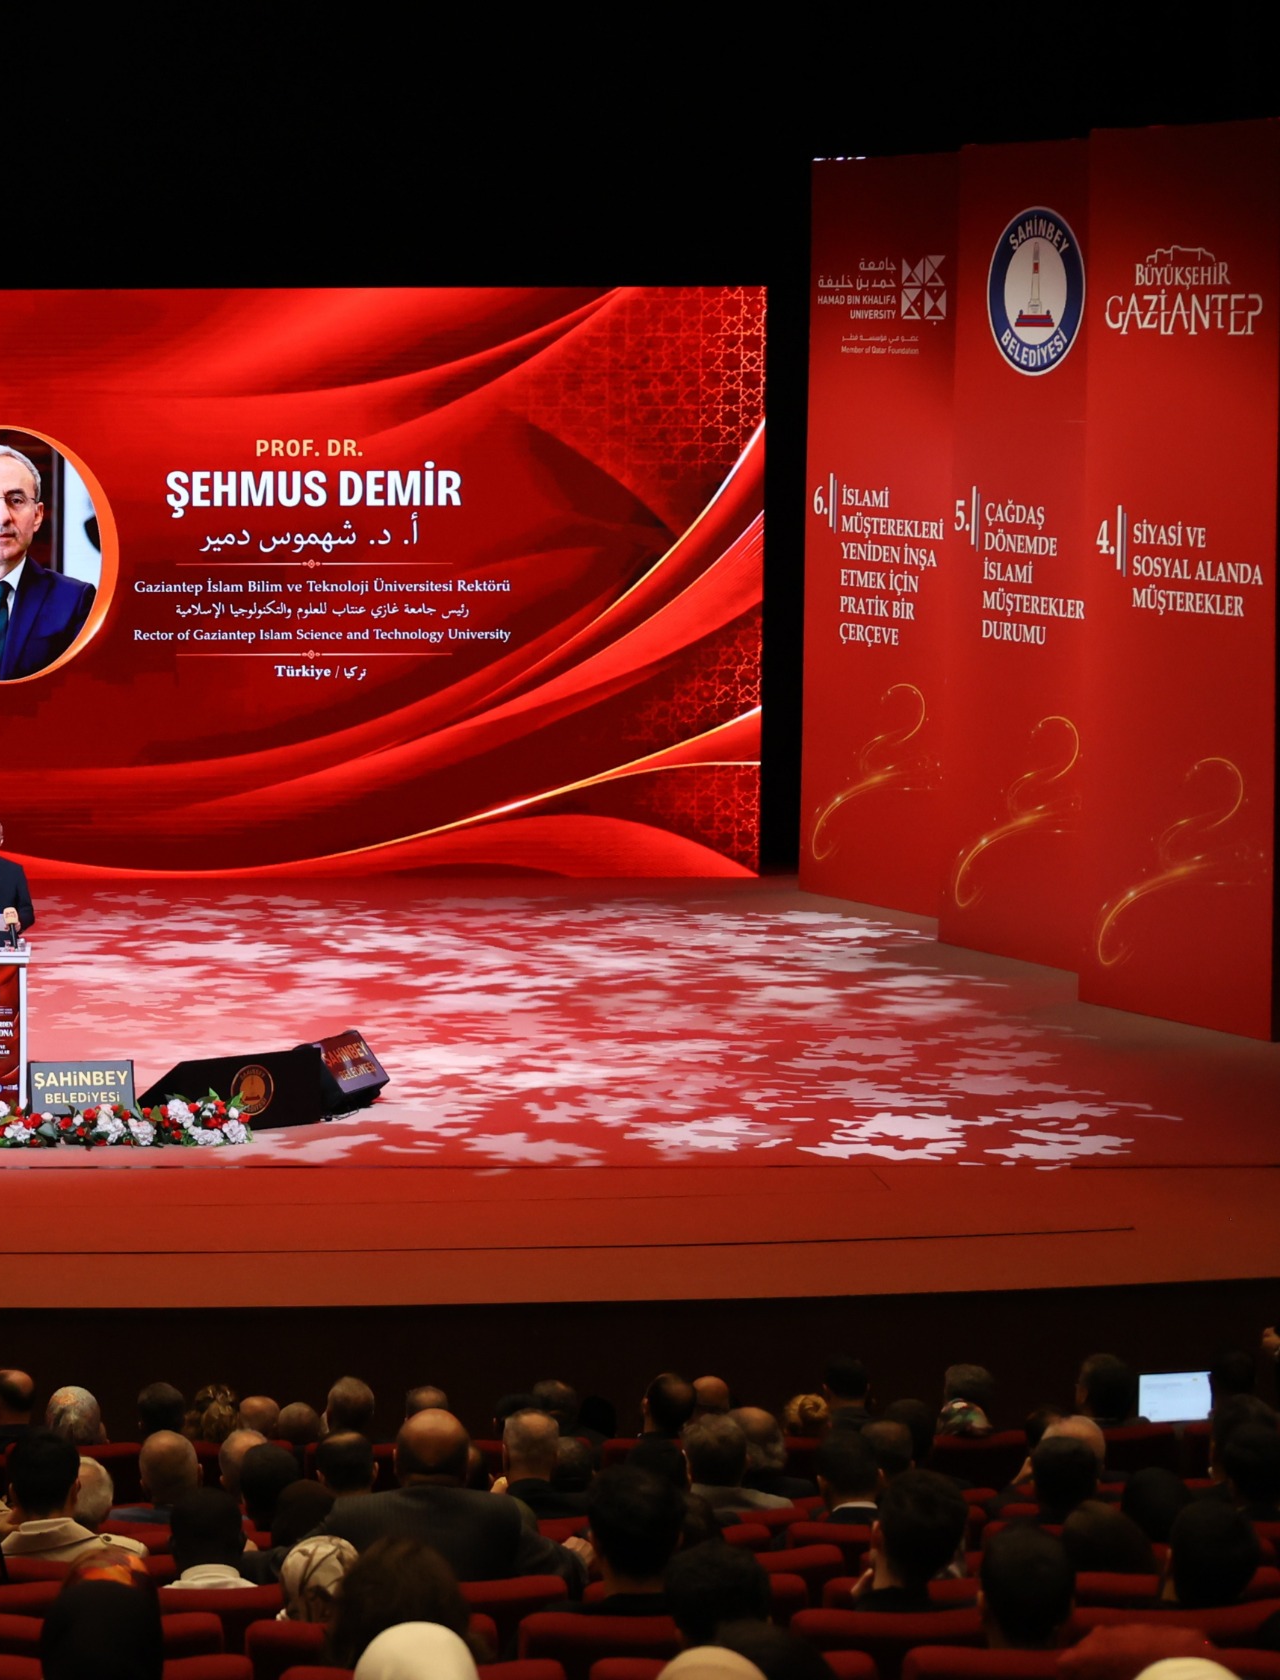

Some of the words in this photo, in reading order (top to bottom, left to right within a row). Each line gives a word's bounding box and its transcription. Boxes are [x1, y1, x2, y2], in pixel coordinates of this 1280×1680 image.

[859, 258, 896, 273] جامعة
[1135, 261, 1230, 291] BÜYÜKŞEHİR
[818, 295, 845, 304] HAMAD
[847, 295, 860, 304] BIN
[862, 295, 896, 304] KHALIFA
[1105, 287, 1262, 335] GAZİANTEP
[850, 310, 896, 319] UNIVERSITY
[841, 346, 863, 354] Member
[865, 346, 871, 354] of
[1001, 328, 1067, 366] BELEDİYESİ
[257, 439, 319, 456] PROF.
[328, 439, 362, 456] DR.
[167, 471, 326, 518] ŞEHMUS
[340, 461, 461, 506] DEMİR
[814, 486, 830, 517] 6.
[842, 485, 889, 508] İSLAMİ
[955, 500, 972, 533] 5.
[985, 500, 1044, 528] ÇAĞDAŞ
[260, 521, 356, 553] شهموس
[370, 529, 390, 544] د.
[404, 512, 418, 544] أ.
[842, 514, 943, 542] MÜŞTEREKLERİ
[1096, 520, 1115, 554] 4.
[1134, 519, 1182, 546] SİYASİ
[1186, 527, 1205, 547] VE
[200, 530, 250, 551] دمير
[985, 529, 1057, 558] DÖNEMDE
[841, 540, 900, 563] YENİDEN
[904, 546, 937, 570] İNŞA
[841, 569, 886, 589] ETMEK
[889, 570, 918, 595] İÇİN
[984, 559, 1033, 583] İSLAMİ
[1133, 556, 1191, 579] SOSYAL
[1195, 561, 1263, 585] ALANDA
[134, 581, 203, 596] Gaziantep
[207, 578, 243, 592] İslam
[248, 581, 282, 592] Bilim
[287, 584, 302, 592] ve
[307, 580, 368, 595] Teknoloji
[374, 578, 452, 591] Üniversitesi
[458, 580, 510, 591] Rektörü
[176, 602, 224, 618] الإسلامية
[230, 600, 291, 619] والتكنولوجيا
[297, 602, 326, 619] للعلوم
[332, 604, 366, 616] عنتاب
[371, 603, 399, 618] غازي
[404, 603, 436, 615] جامعة
[442, 604, 469, 619] رئيس
[840, 596, 889, 617] PRATİK
[893, 598, 914, 620] BİR
[983, 588, 1084, 622] MÜŞTEREKLER
[1132, 585, 1244, 616] MÜŞTEREKLER
[134, 630, 174, 640] Rector
[177, 629, 190, 640] of
[193, 630, 255, 643] Gaziantep
[260, 629, 292, 639] Islam
[297, 629, 342, 639] Science
[347, 629, 369, 639] and
[373, 629, 444, 643] Technology
[448, 629, 511, 642] University
[840, 623, 898, 647] ÇERÇEVE
[982, 620, 1046, 645] DURUMU
[274, 665, 331, 680] Türkiye
